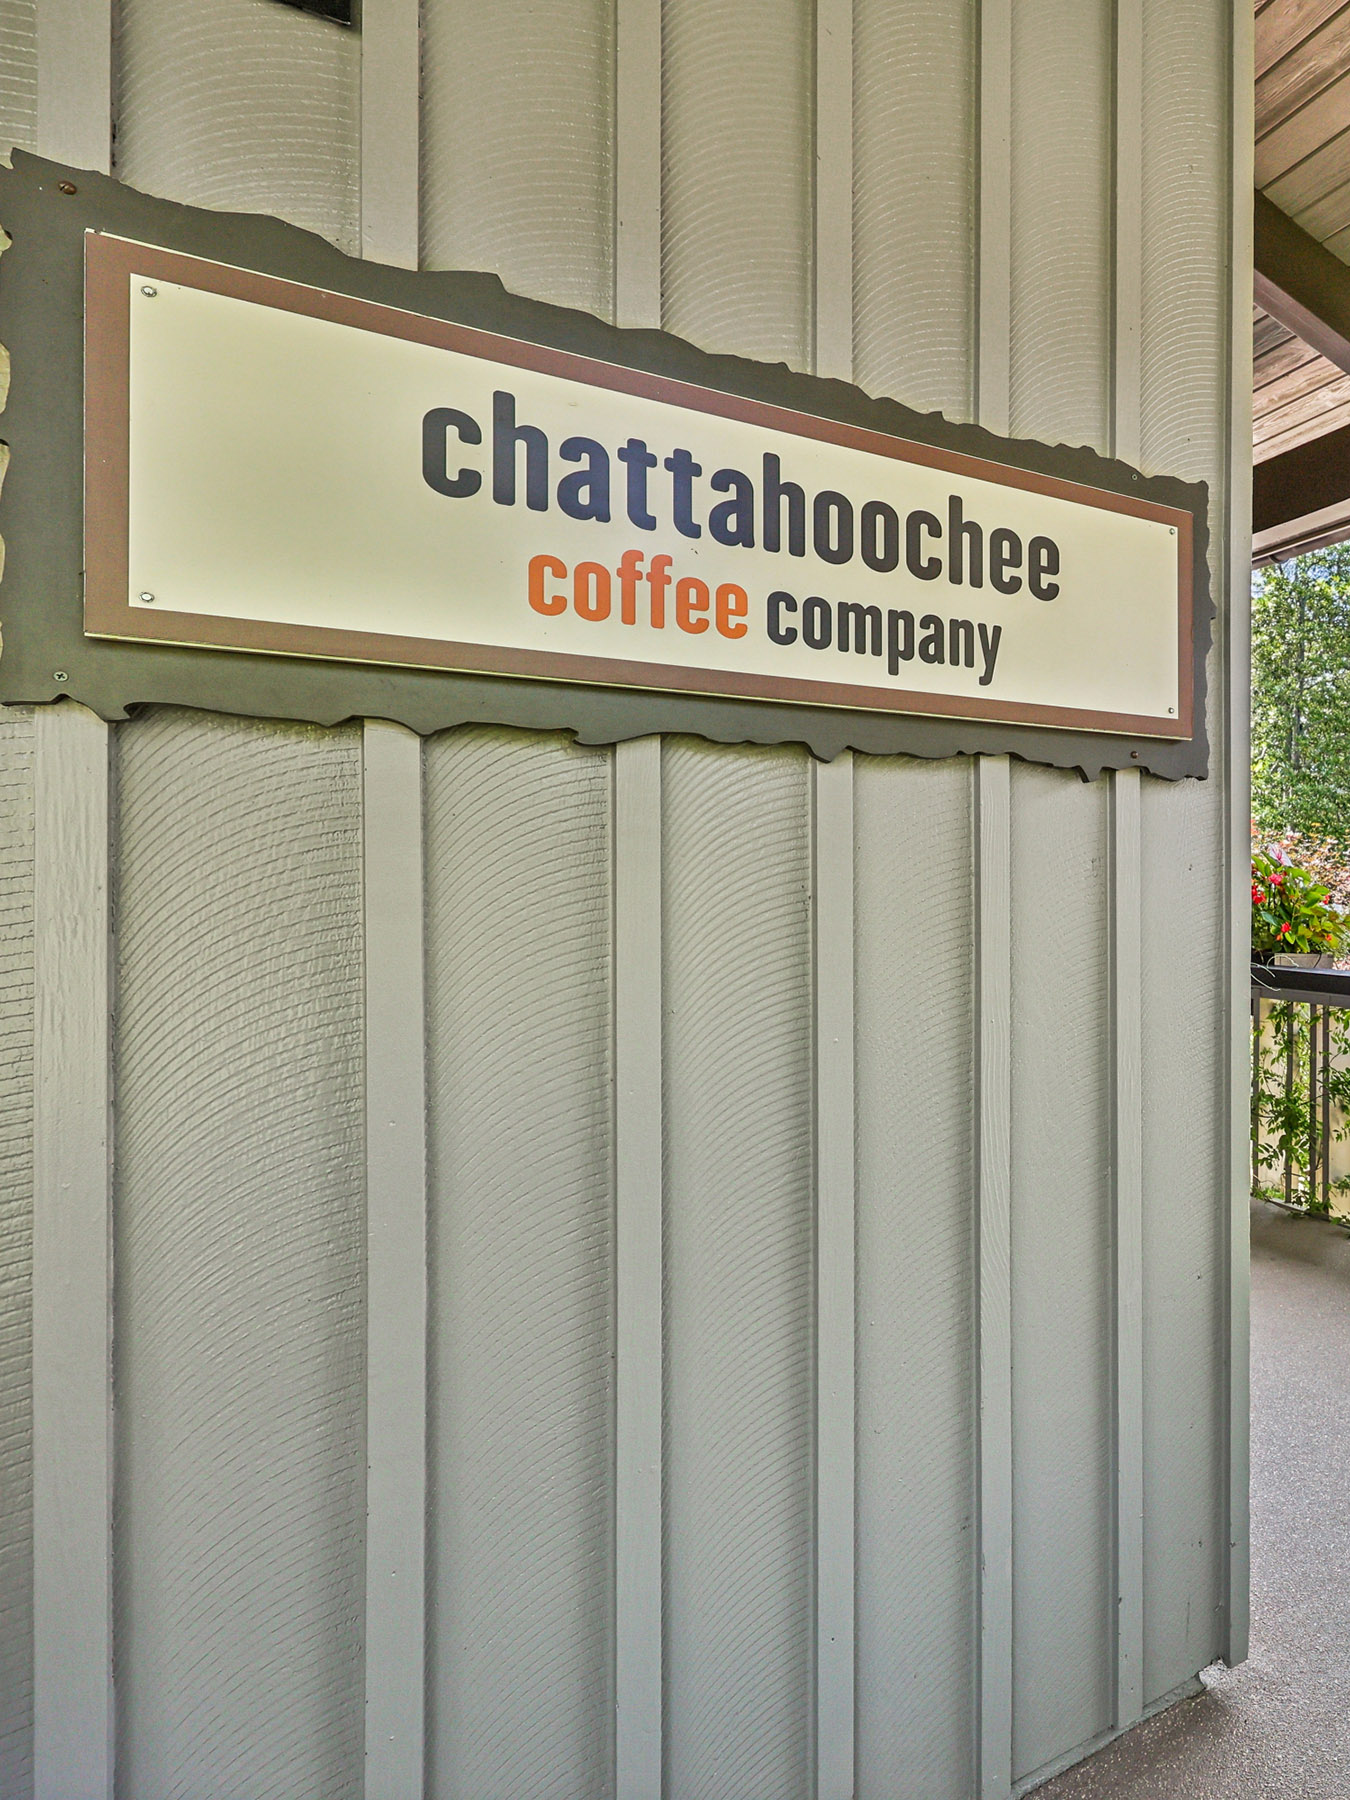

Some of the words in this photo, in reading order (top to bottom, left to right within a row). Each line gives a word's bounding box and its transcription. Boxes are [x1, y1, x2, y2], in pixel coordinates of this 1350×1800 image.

[422, 390, 1060, 602] chattahoochee
[528, 549, 748, 640] coffee
[766, 590, 1003, 686] company
